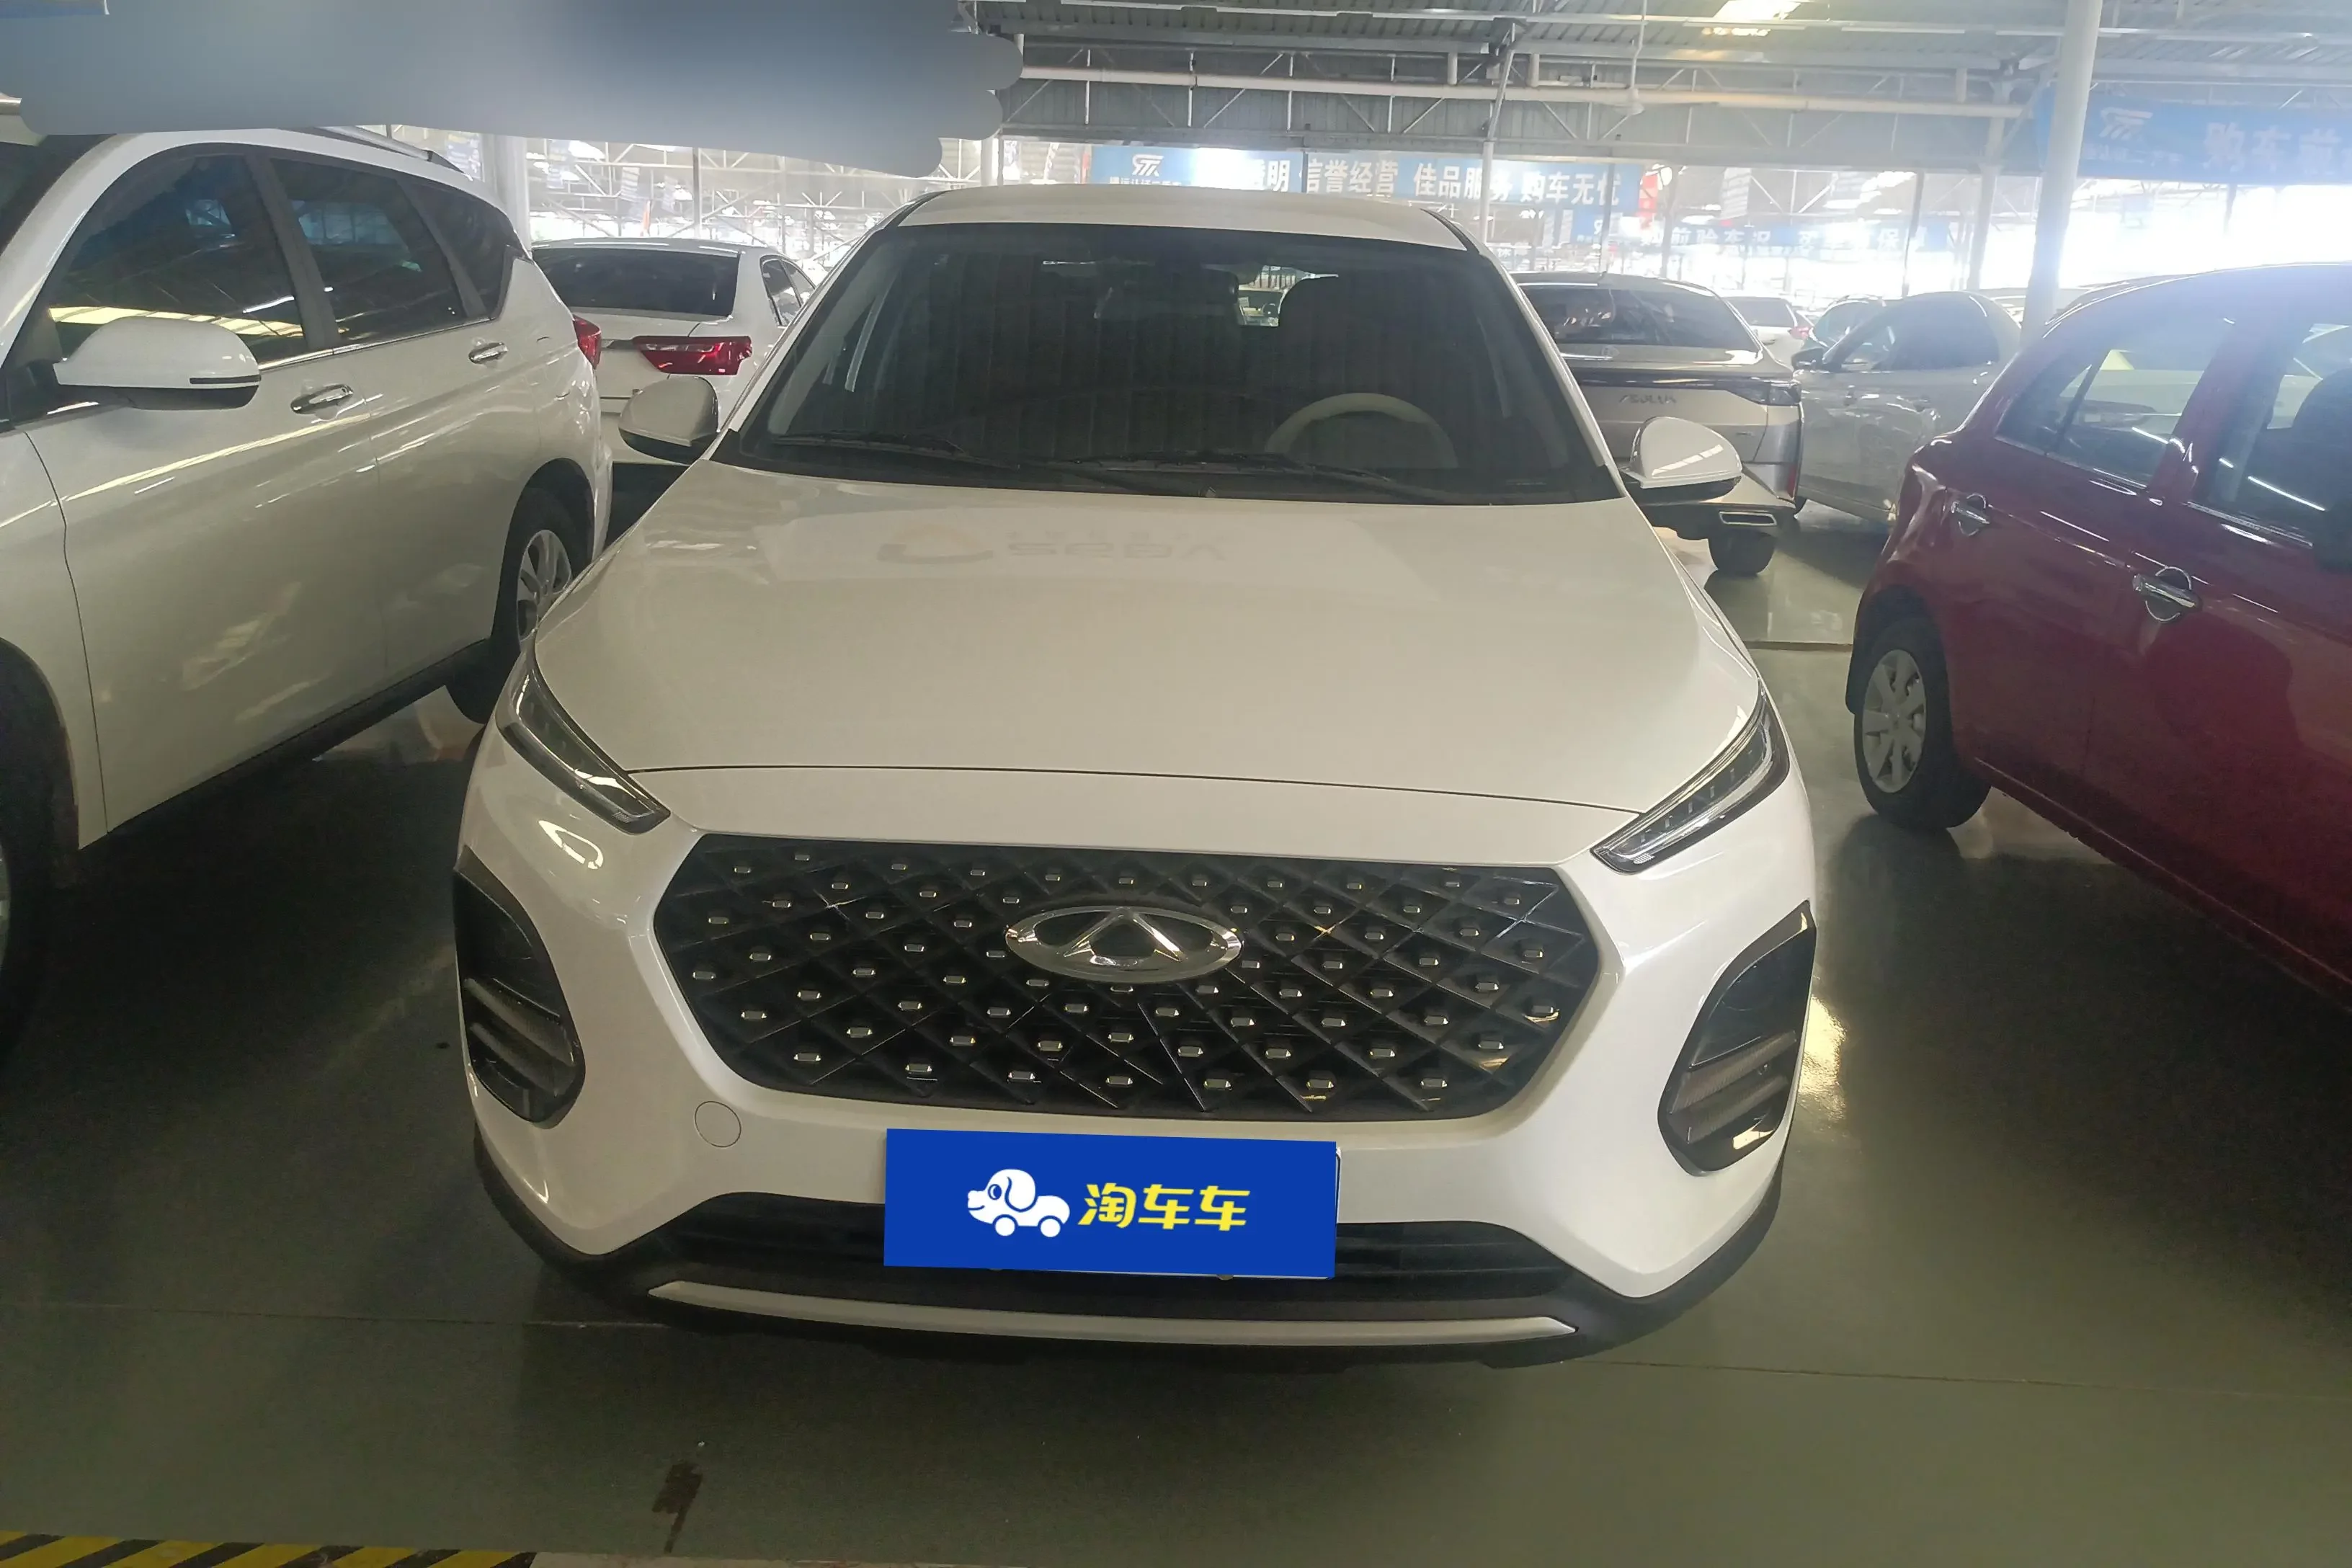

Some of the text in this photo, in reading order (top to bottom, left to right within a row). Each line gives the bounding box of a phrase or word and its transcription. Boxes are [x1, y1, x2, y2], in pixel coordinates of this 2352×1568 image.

[1299, 159, 1399, 194] 信誉经营
[1414, 163, 1513, 202] 佳品服务
[1520, 172, 1621, 206] 购车无忧
